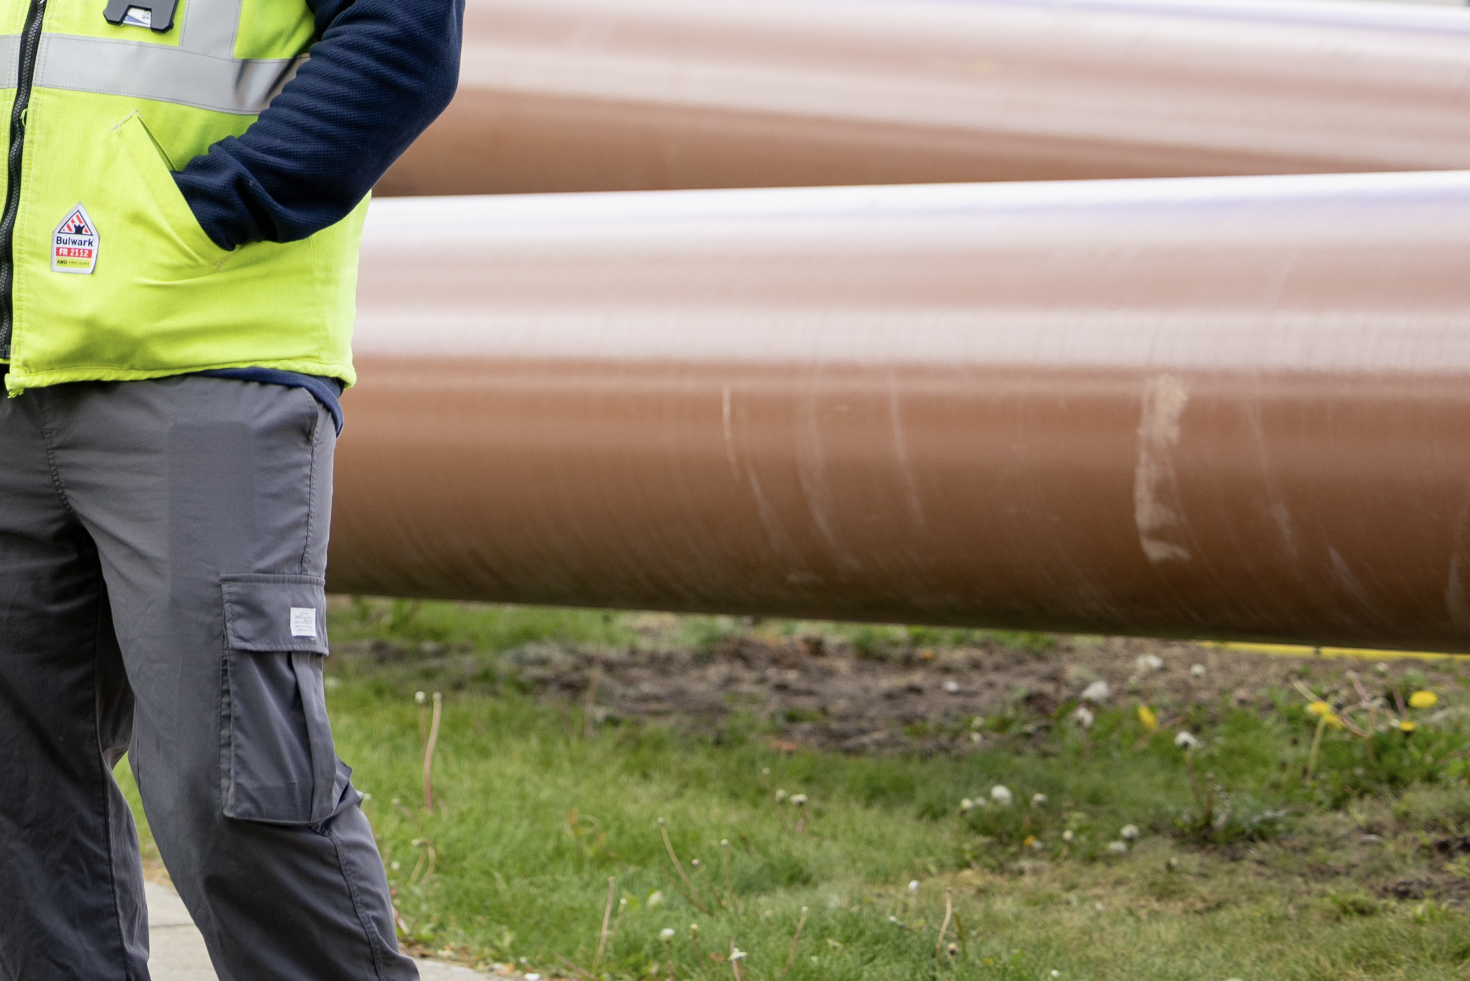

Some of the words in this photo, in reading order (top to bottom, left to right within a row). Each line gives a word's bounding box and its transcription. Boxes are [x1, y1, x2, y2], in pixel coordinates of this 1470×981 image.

[56, 235, 94, 247] Bulwark
[58, 248, 68, 256] FR
[70, 248, 89, 257] 2112
